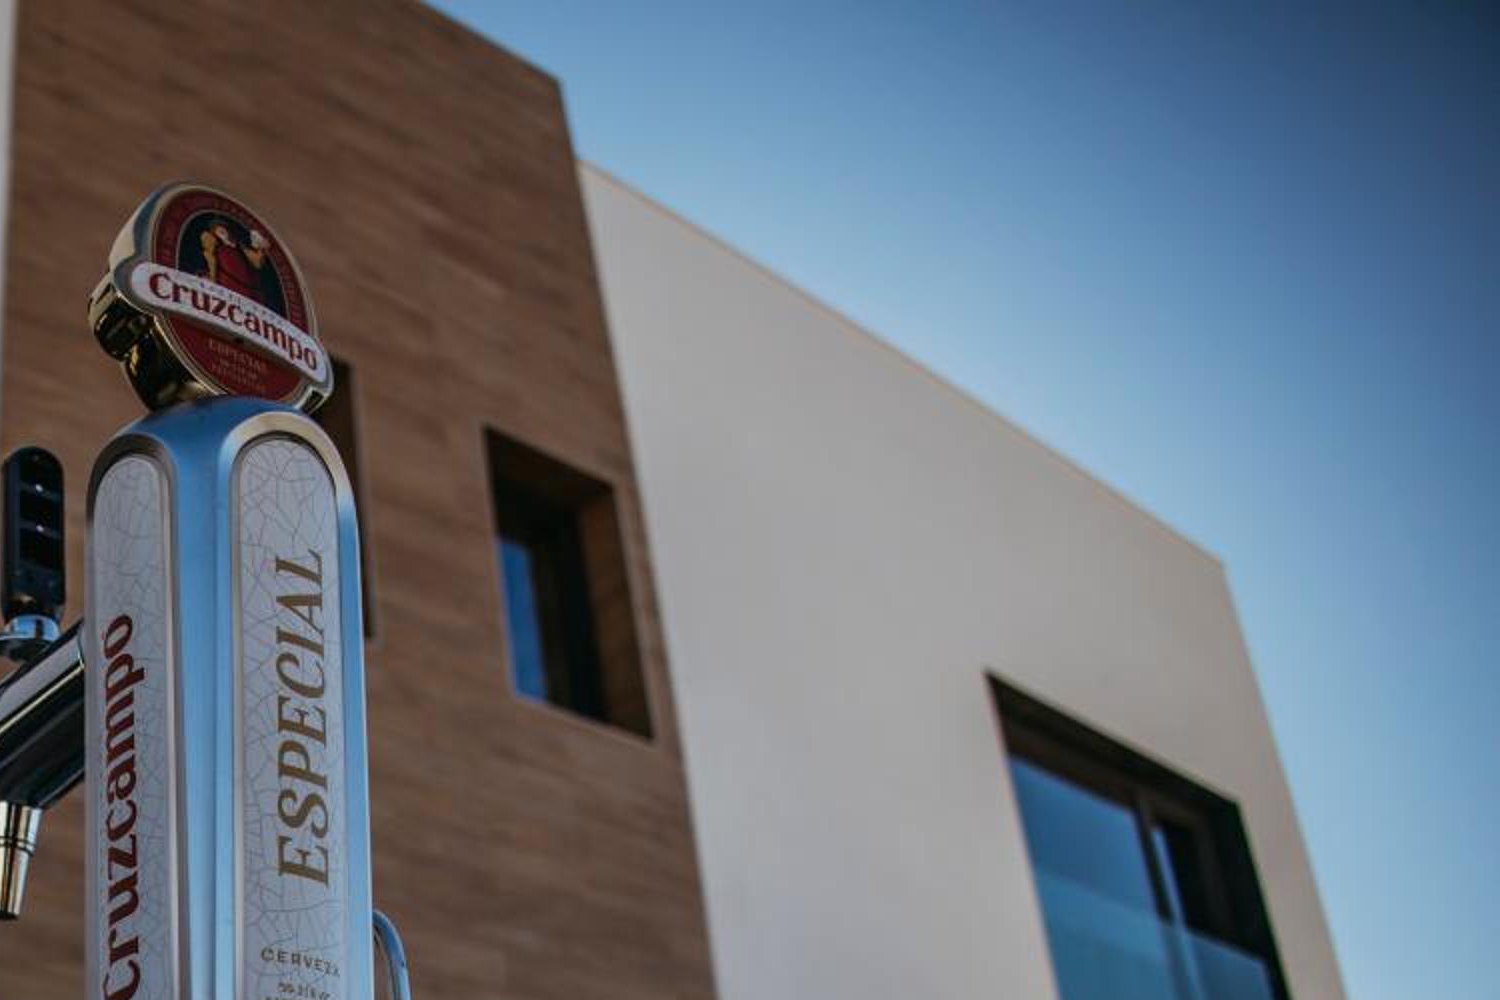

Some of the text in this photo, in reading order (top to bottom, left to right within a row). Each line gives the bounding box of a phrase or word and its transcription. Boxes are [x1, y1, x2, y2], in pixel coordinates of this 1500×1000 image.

[148, 272, 317, 371] Cruzcampo
[275, 549, 329, 886] ESPECIAL
[261, 948, 339, 976] CERVEZA
